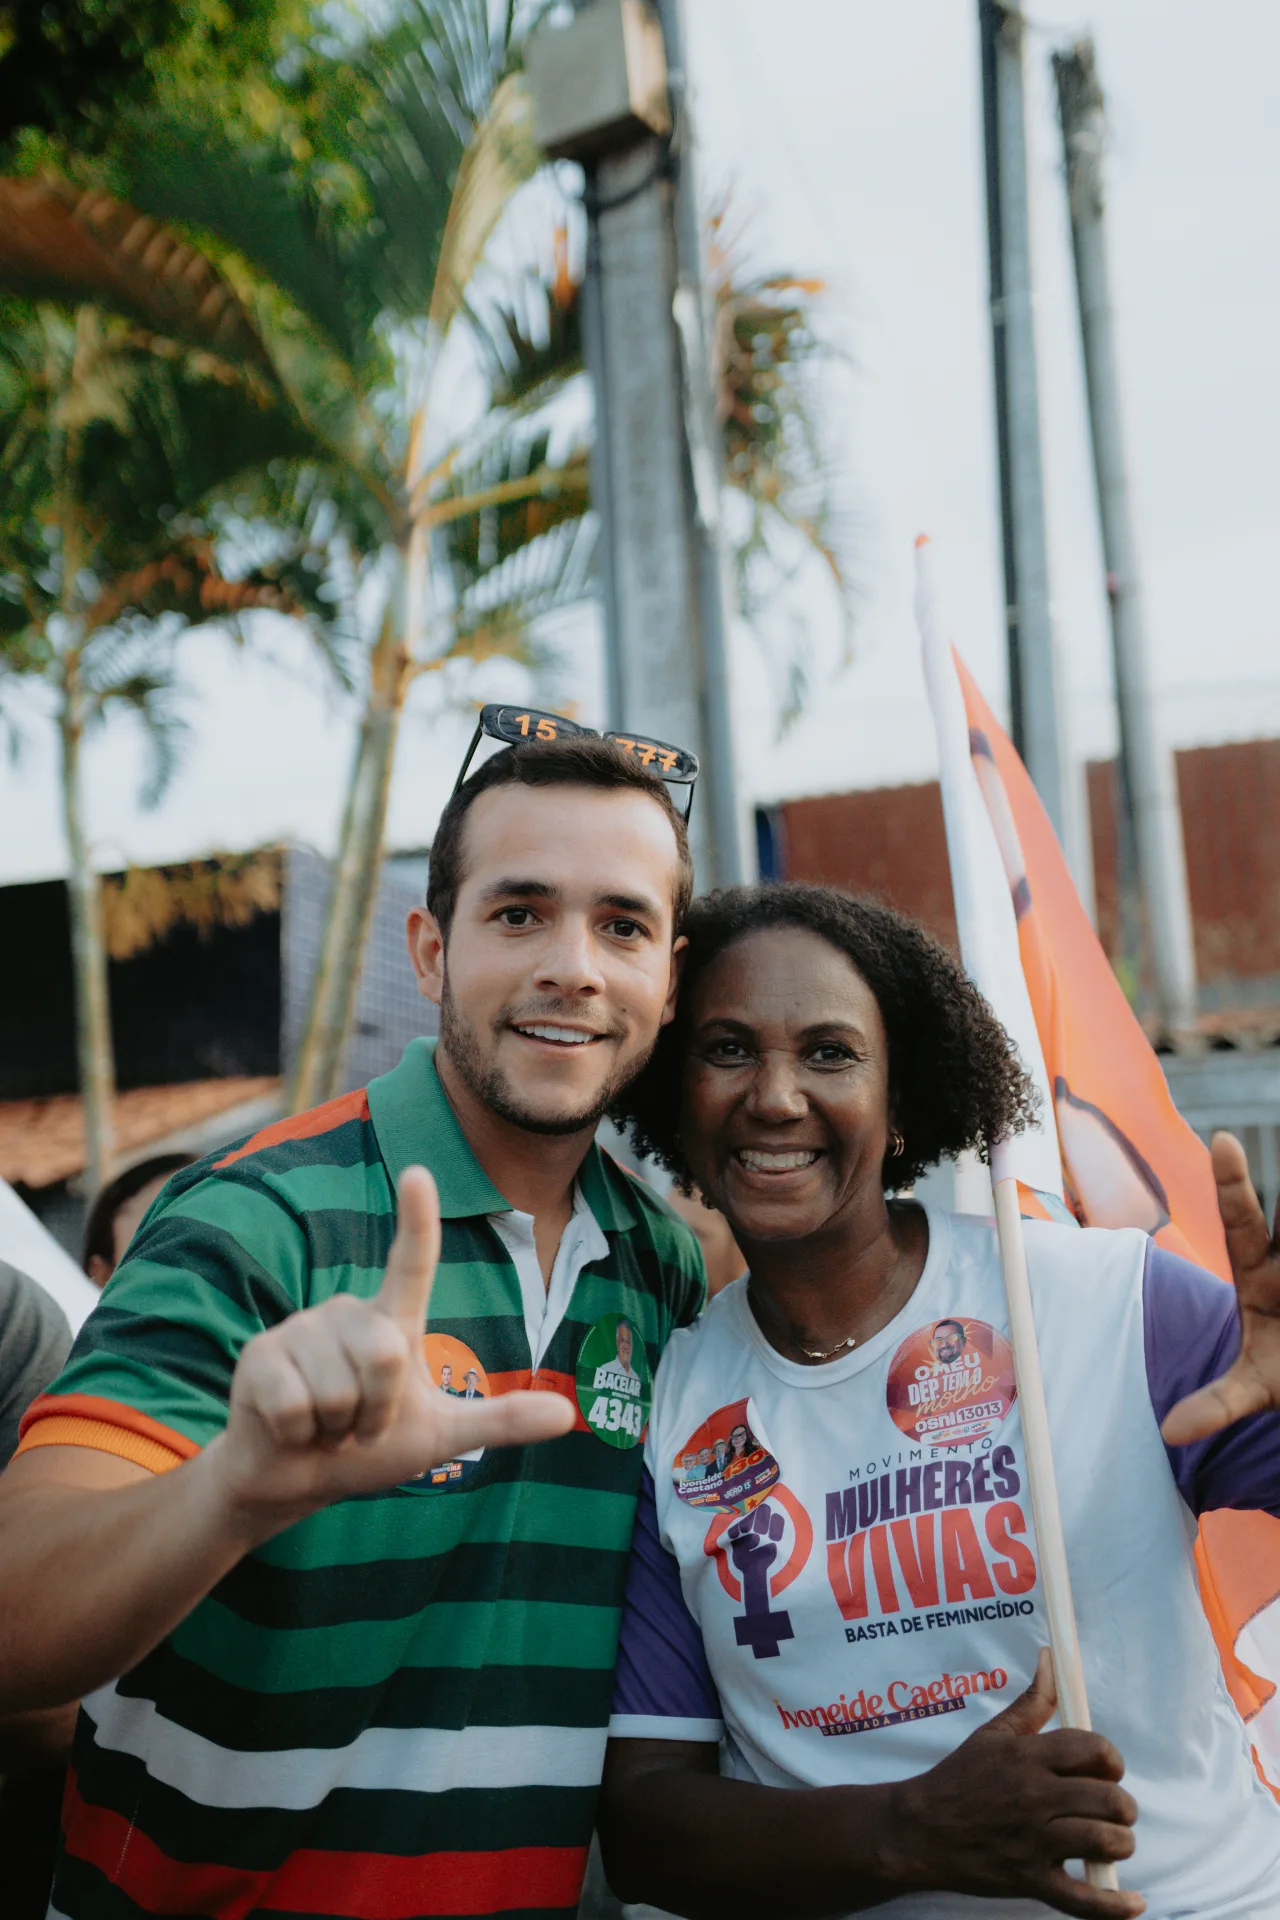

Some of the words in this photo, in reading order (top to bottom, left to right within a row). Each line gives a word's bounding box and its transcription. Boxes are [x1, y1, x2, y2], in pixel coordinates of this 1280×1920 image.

[515, 715, 557, 741] 15
[593, 1367, 641, 1398] BACELAR
[907, 1377, 940, 1407] DEP.
[588, 1396, 642, 1438] 4343
[958, 1401, 1001, 1421] 13013
[849, 1437, 993, 1481] MOVIMENTO
[678, 1479, 723, 1494] Caetano
[679, 1471, 723, 1488] Ivoneide
[825, 1445, 1021, 1541] MULHERES
[826, 1501, 1037, 1621] VIVAS
[844, 1621, 899, 1643] BASTA
[901, 1616, 924, 1634] DE
[926, 1600, 1035, 1630] FEMINICÍDIO
[774, 1689, 885, 1730] Ivoneide
[886, 1667, 1008, 1711] Caetano
[822, 1715, 891, 1736] DEPUTADA
[900, 1698, 965, 1722] FEDERAL
